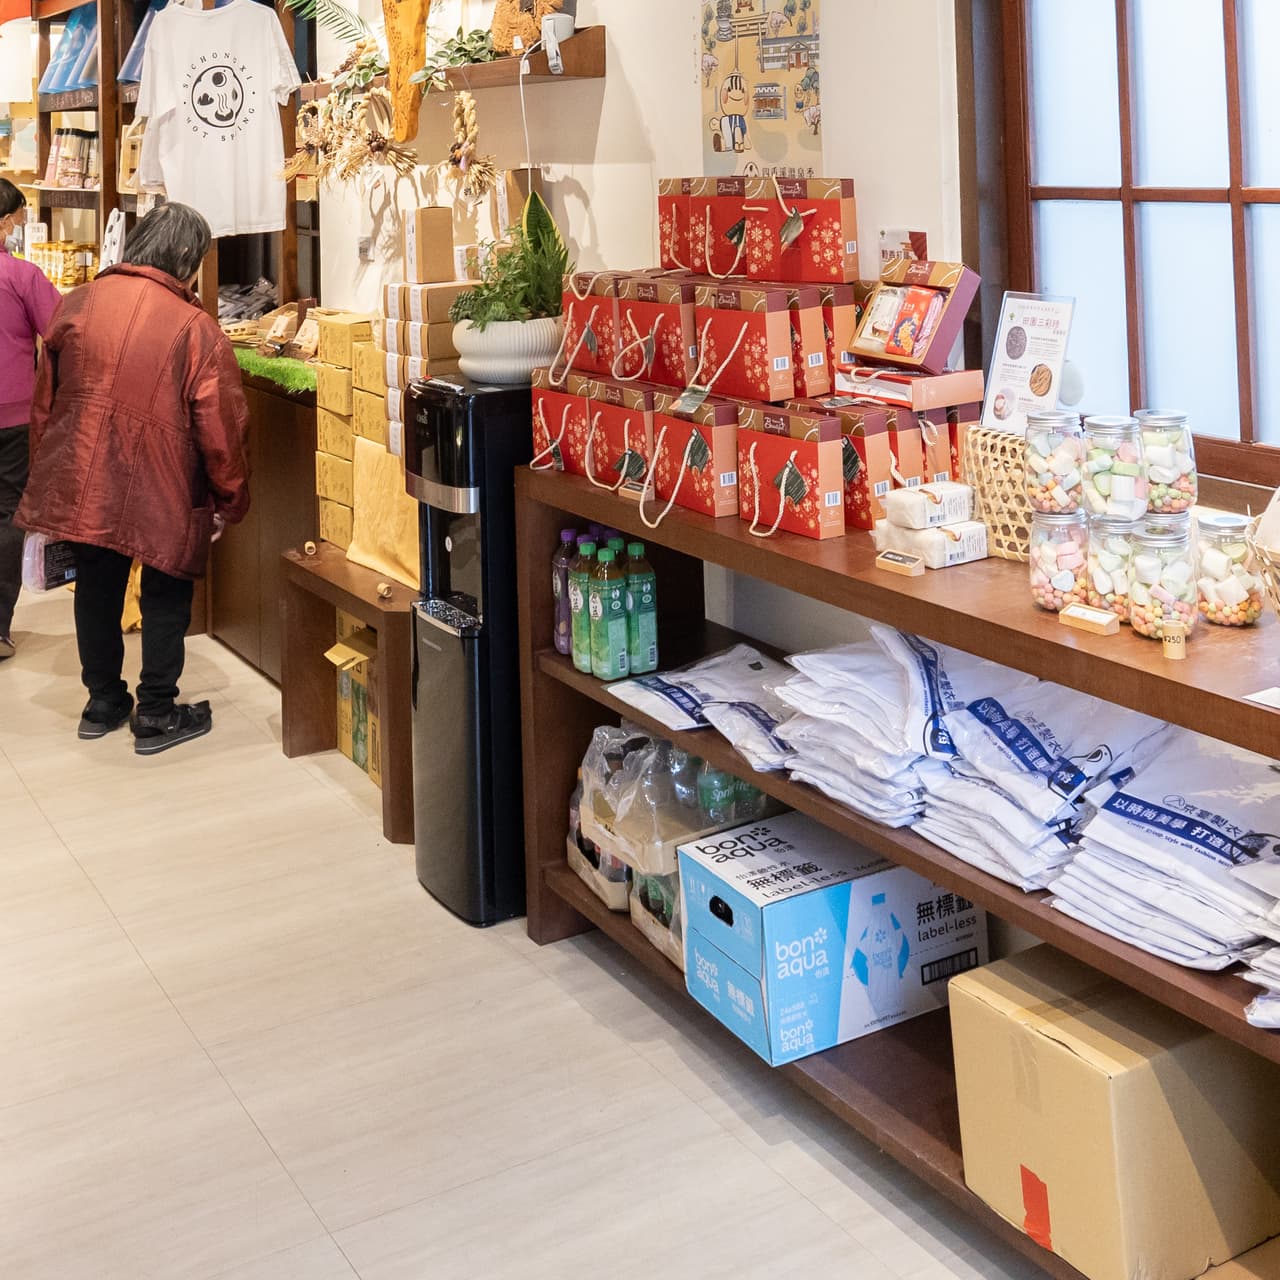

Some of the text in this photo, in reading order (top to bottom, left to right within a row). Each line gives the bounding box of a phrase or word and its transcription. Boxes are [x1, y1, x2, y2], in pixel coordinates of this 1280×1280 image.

[220, 106, 256, 142] SPING
[710, 837, 790, 864] aqua
[918, 914, 977, 943] label-less
[775, 934, 815, 961] bon
[777, 949, 829, 980] aqua
